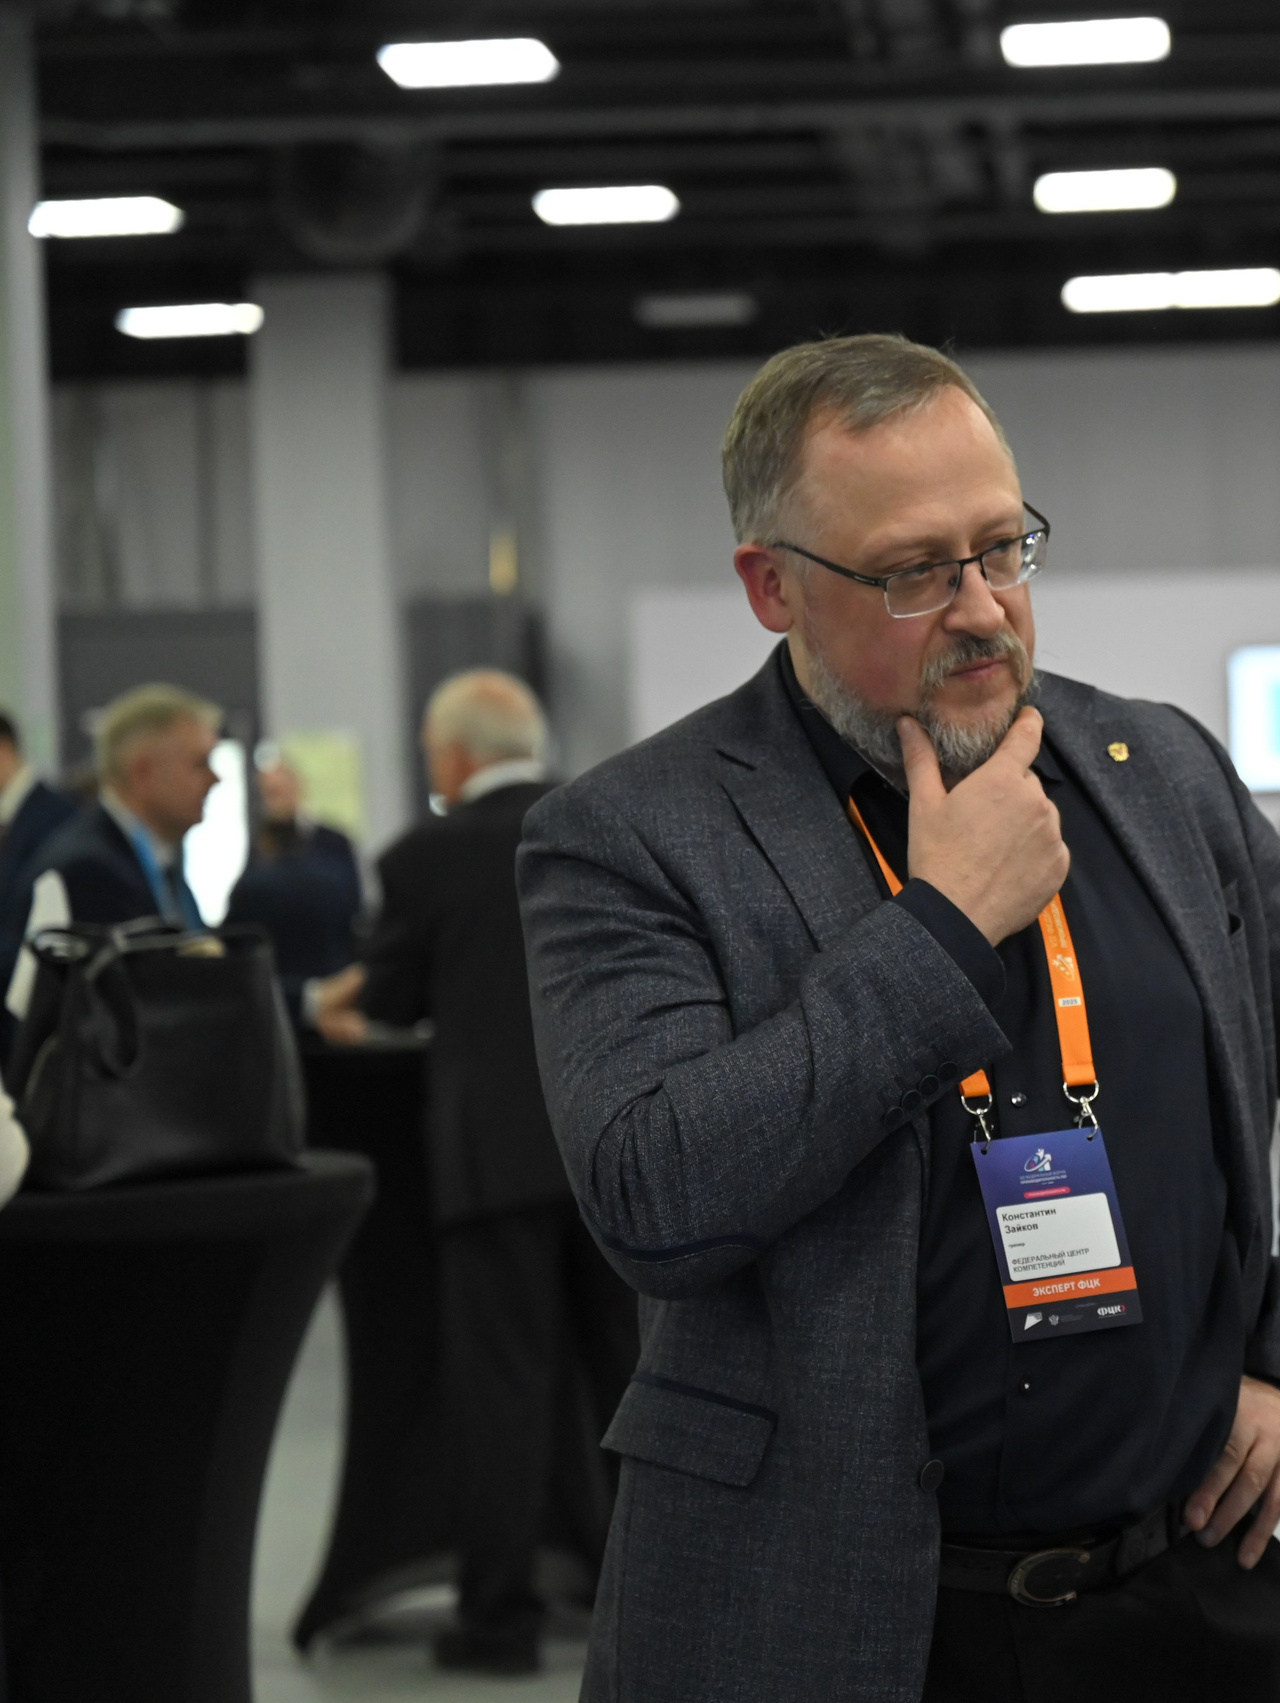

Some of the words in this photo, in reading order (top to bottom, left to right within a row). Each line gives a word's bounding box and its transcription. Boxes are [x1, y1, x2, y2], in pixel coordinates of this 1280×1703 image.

[1002, 1208, 1057, 1222] Константин
[1005, 1223, 1039, 1234] Зайков
[1011, 1250, 1066, 1266] ФЕДЕРАЛЬНЫЙ
[1067, 1248, 1090, 1259] ЦЕНТР
[1013, 1259, 1066, 1273] КОМПЕТЕНЦИЙ
[1032, 1281, 1076, 1297] ЭКСПЕРТ
[1077, 1278, 1101, 1290] ФЦК
